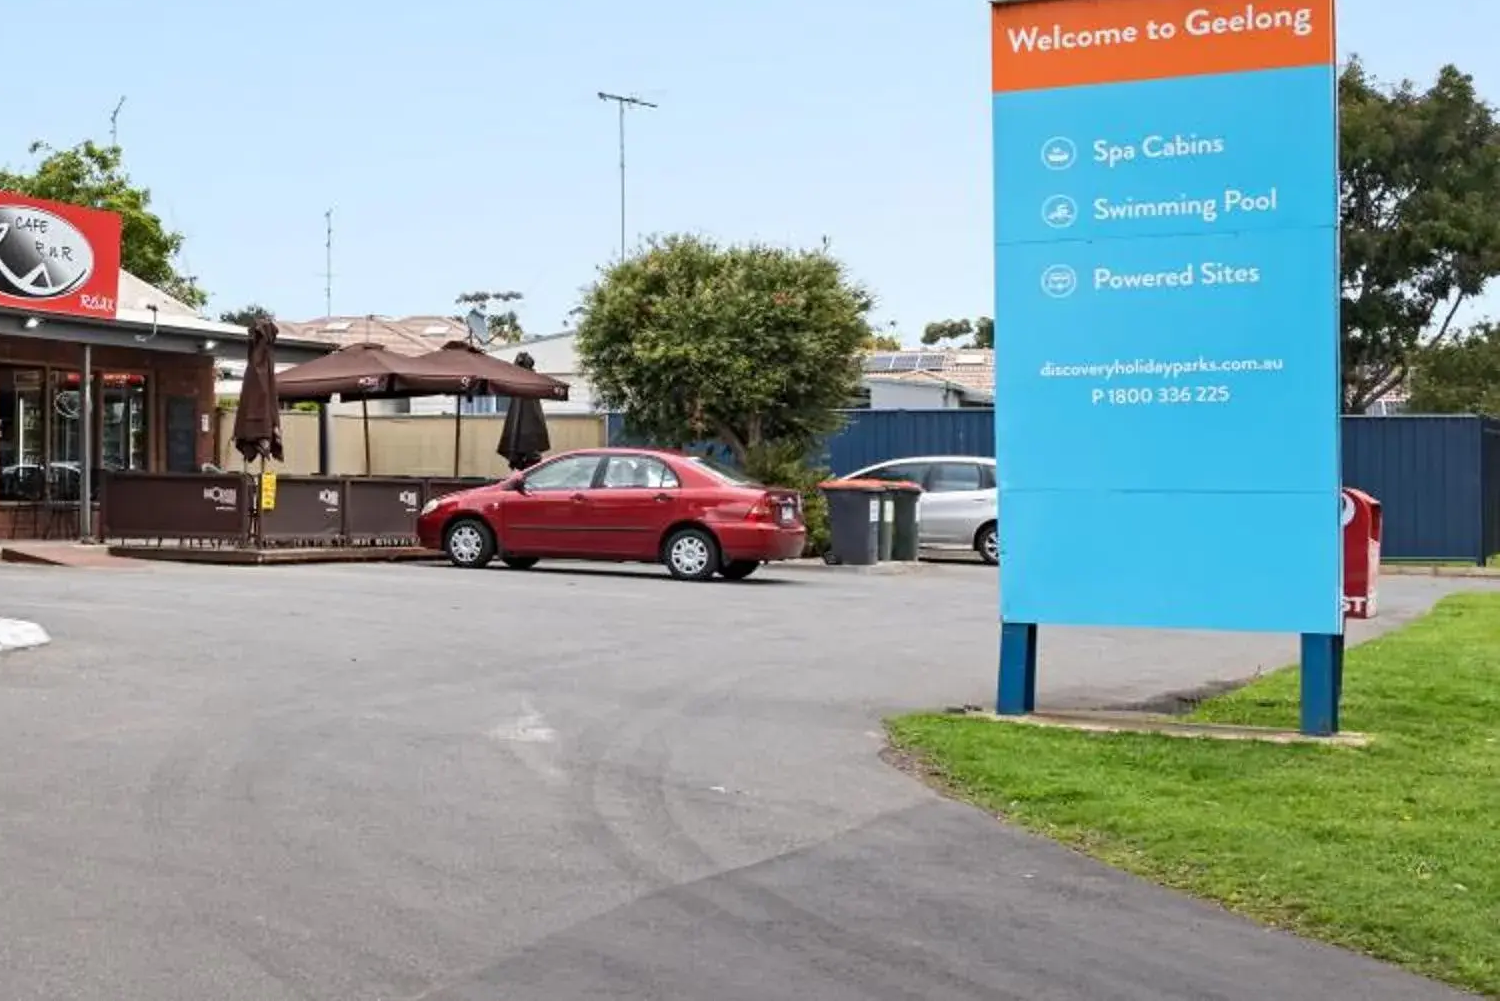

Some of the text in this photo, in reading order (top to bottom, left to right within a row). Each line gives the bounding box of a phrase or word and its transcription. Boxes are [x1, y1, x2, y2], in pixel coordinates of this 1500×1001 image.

[1007, 5, 1312, 53] Welcome to Geelong
[1093, 134, 1225, 167] Spa Cabins
[1093, 187, 1277, 222] Swimming Pool
[15, 216, 49, 234] CAFE
[1093, 262, 1260, 289] Powered Sites
[1040, 356, 1283, 379] discoveryholidayparks.com.au
[1091, 385, 1230, 404] P 1800 336 225
